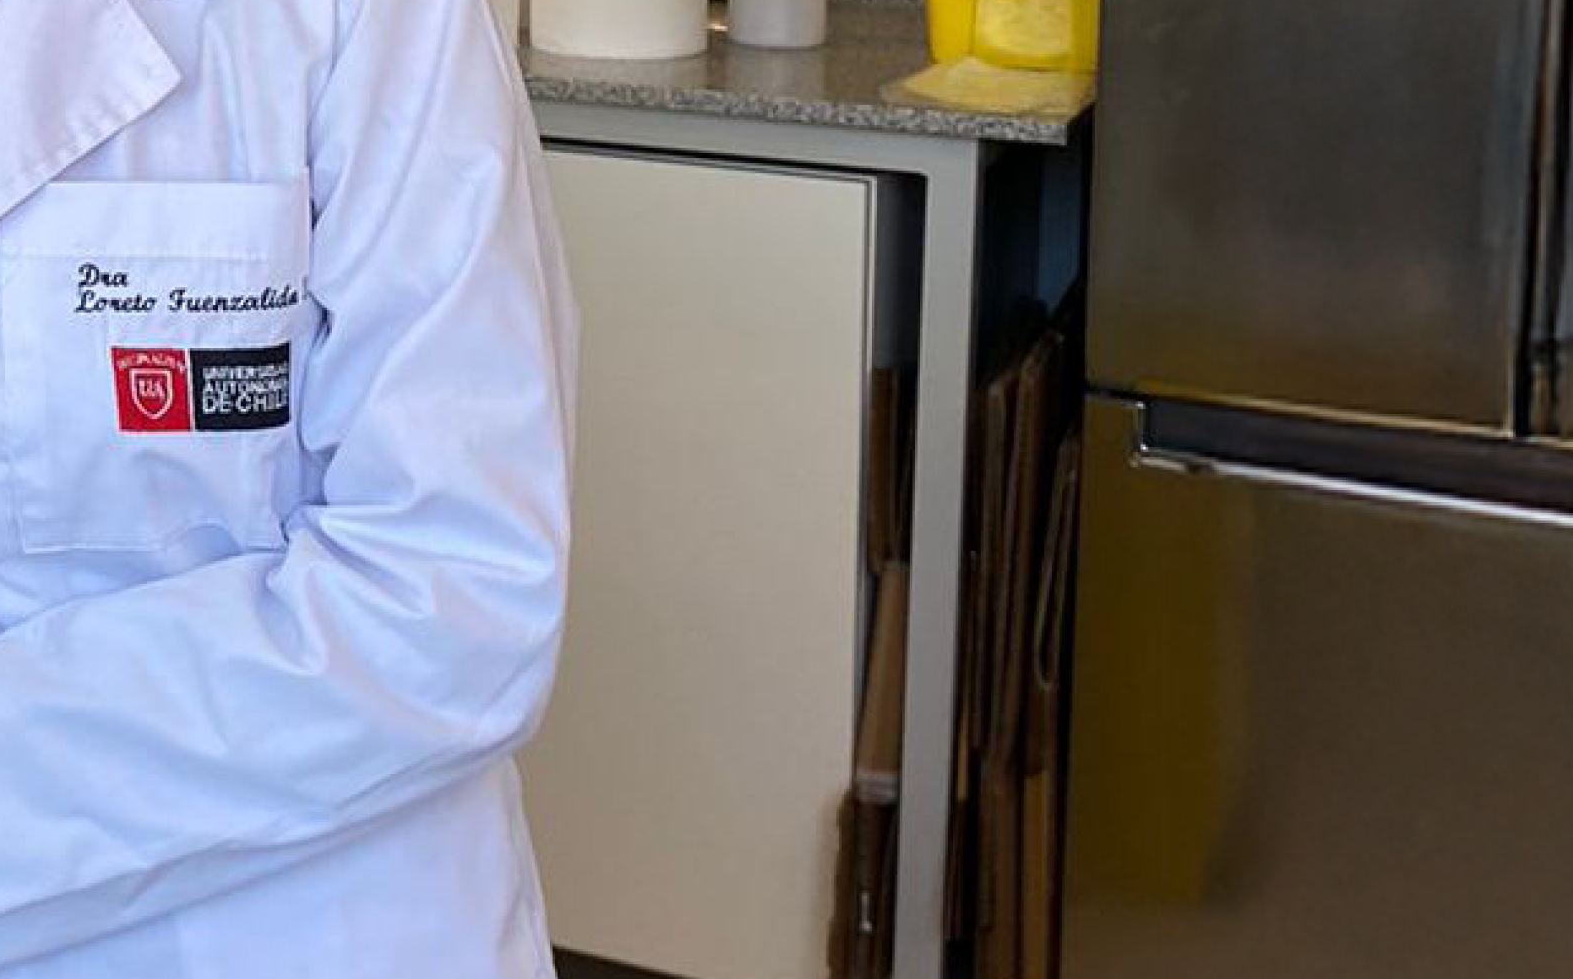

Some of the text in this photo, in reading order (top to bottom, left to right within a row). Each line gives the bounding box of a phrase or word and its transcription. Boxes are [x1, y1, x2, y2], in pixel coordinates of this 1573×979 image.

[77, 262, 128, 287] Dra
[74, 289, 157, 313] Loreto
[202, 392, 231, 414] DE
